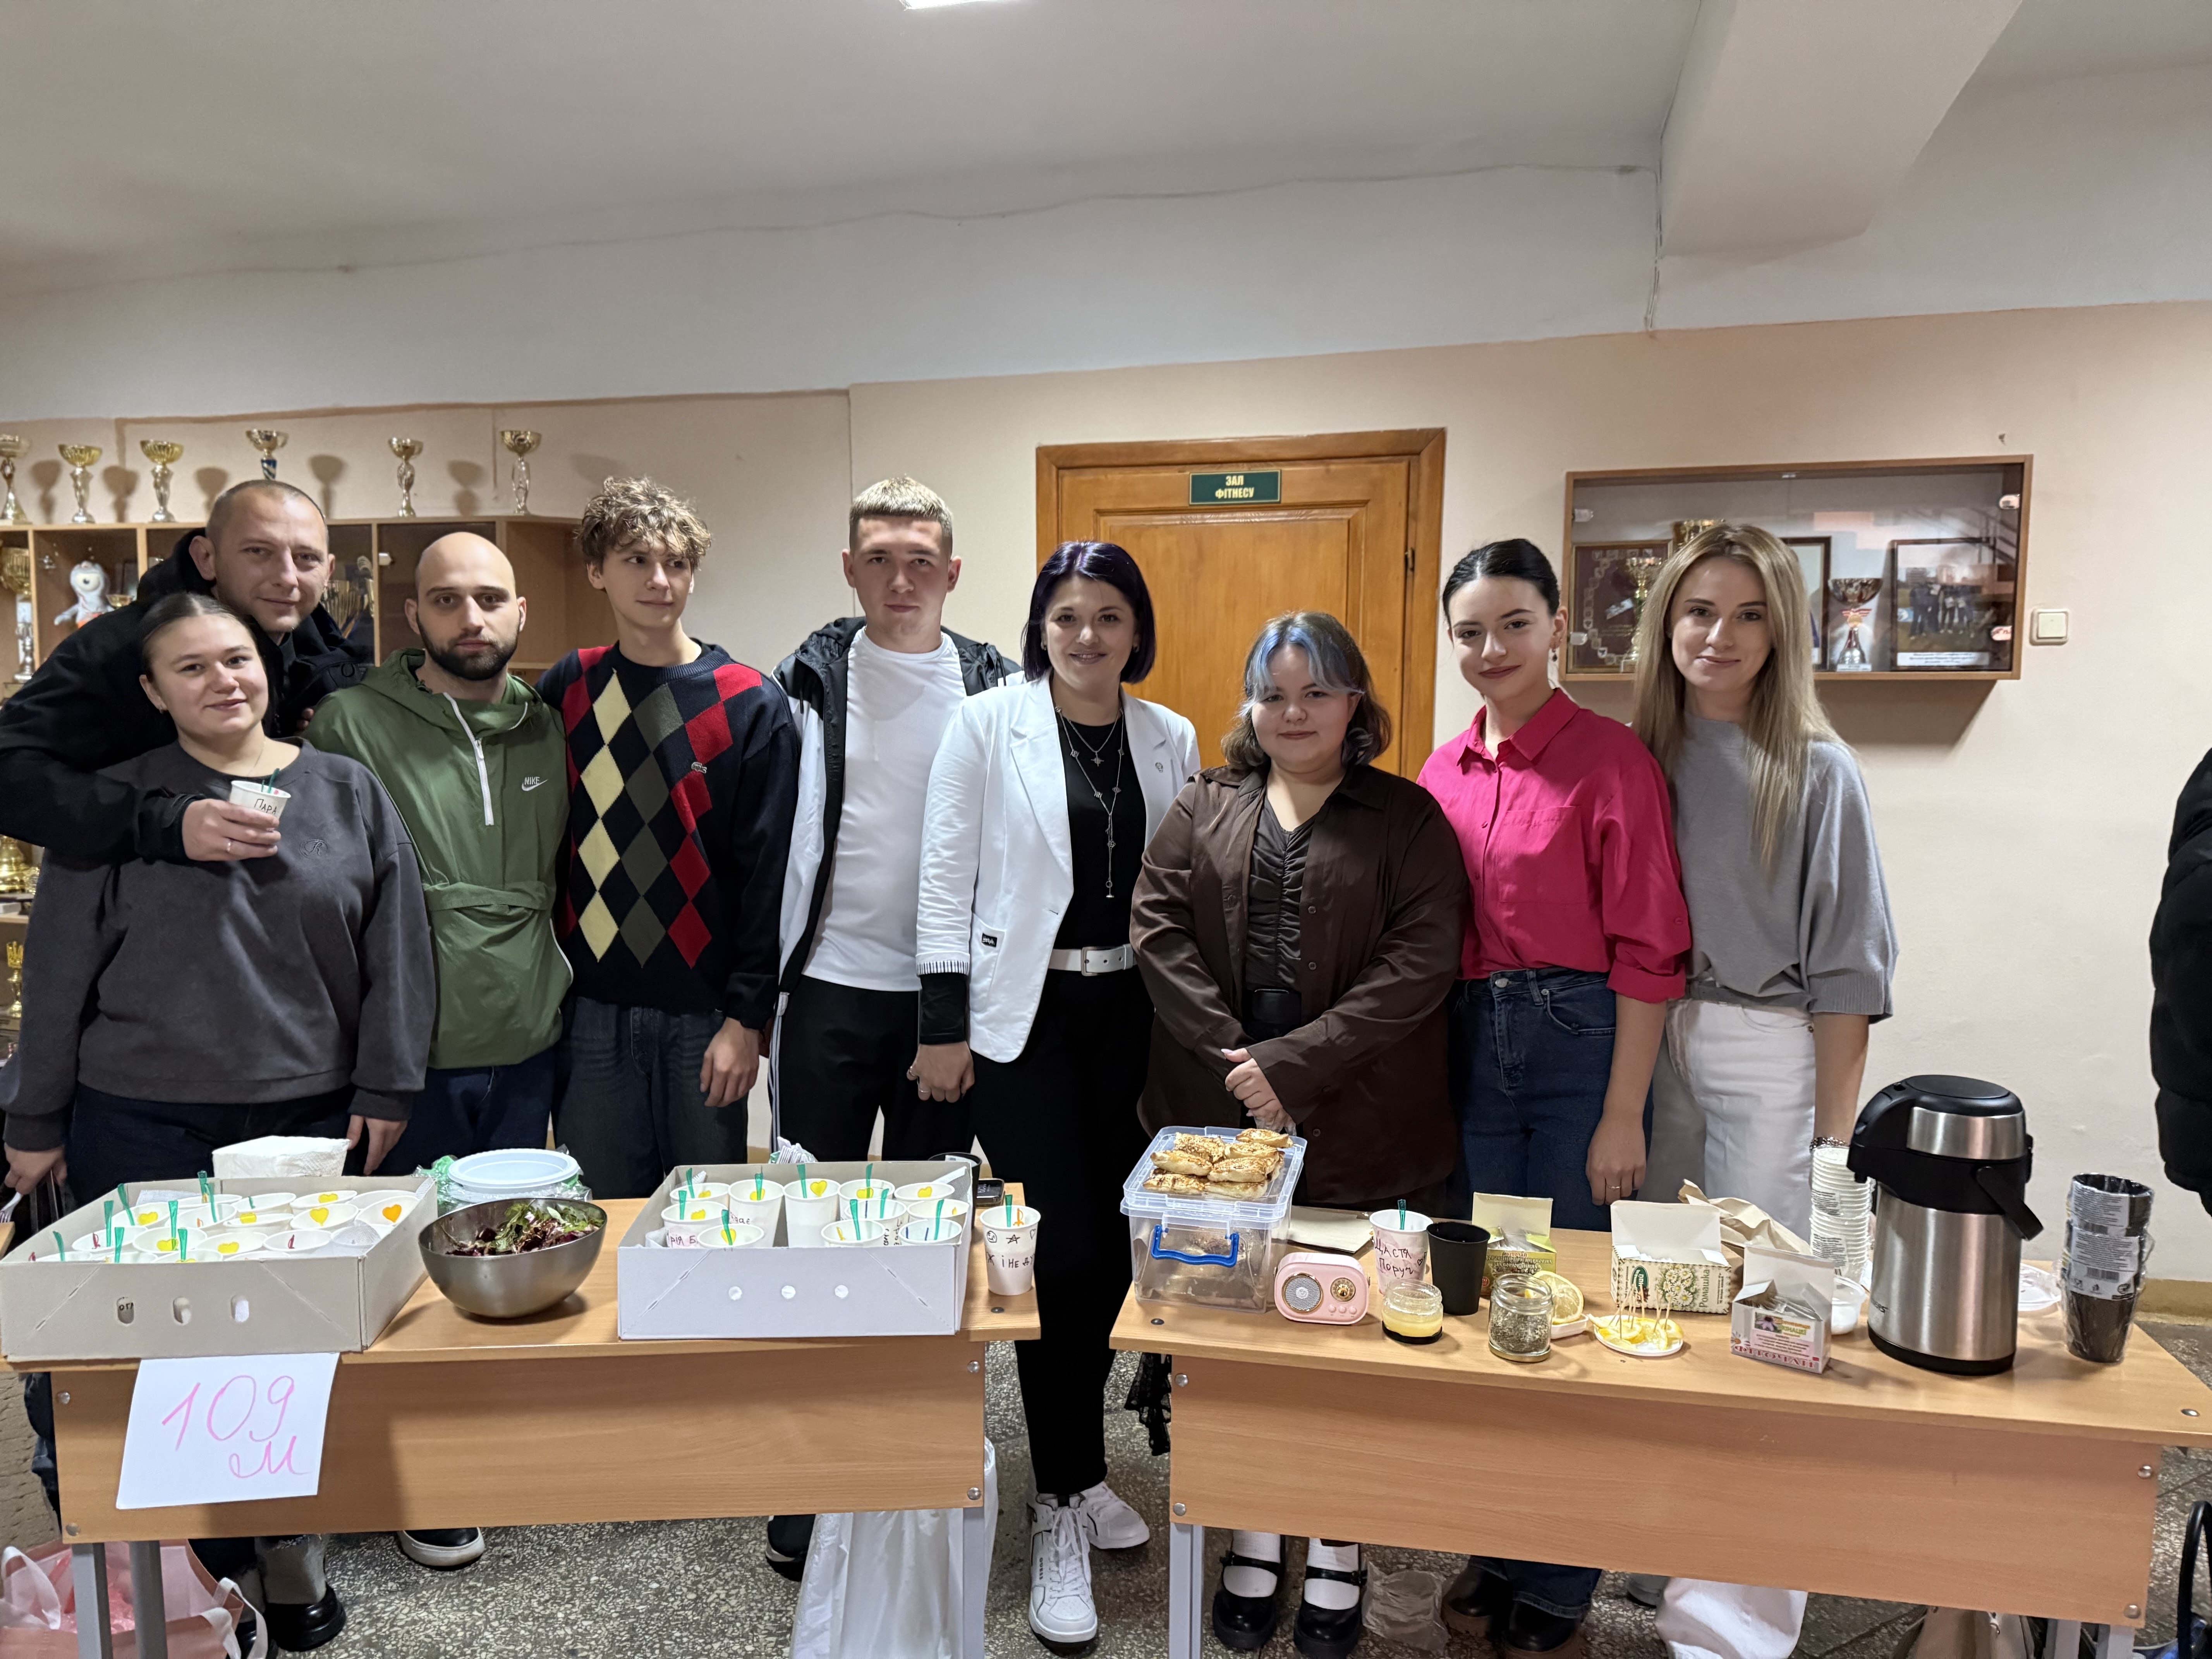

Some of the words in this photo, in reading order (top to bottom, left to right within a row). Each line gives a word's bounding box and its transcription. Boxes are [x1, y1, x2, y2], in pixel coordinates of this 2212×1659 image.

[1225, 475, 1244, 486] ЗАЛ
[1215, 487, 1254, 499] ФІТНЕСУ
[524, 776, 540, 785] NIKE
[1699, 1270, 1710, 1307] Ромашка
[161, 1375, 295, 1451] 109
